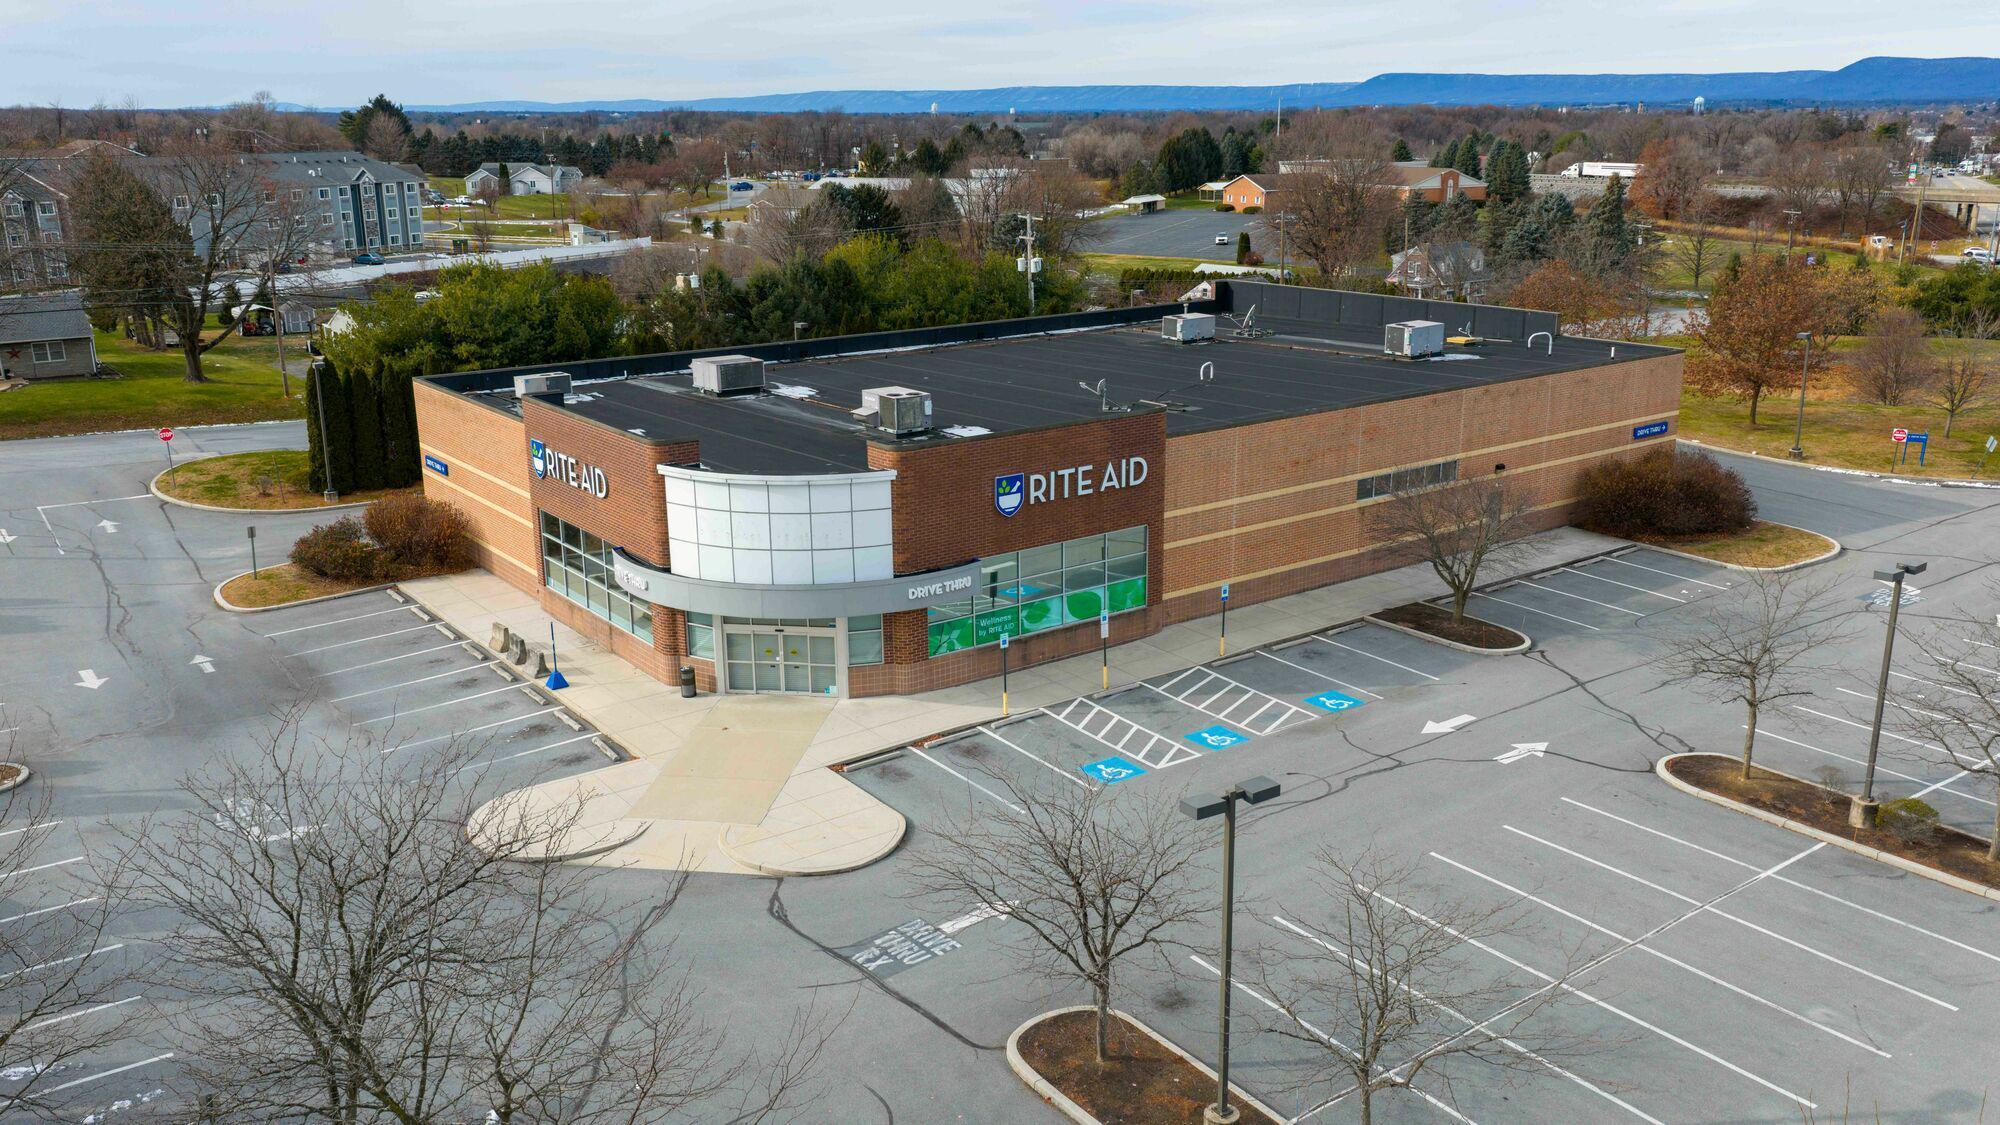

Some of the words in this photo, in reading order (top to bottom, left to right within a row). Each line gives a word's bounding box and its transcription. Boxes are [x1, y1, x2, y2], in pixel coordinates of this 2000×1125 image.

[546, 447, 579, 488] RITE
[581, 464, 607, 498] AID
[1029, 464, 1094, 505] RITE
[1100, 456, 1148, 492] AID
[908, 582, 944, 600] DRIVE
[943, 575, 972, 592] THRU
[980, 615, 1012, 627] Wellness
[873, 930, 932, 965] THRU
[897, 918, 963, 957] DRIVE
